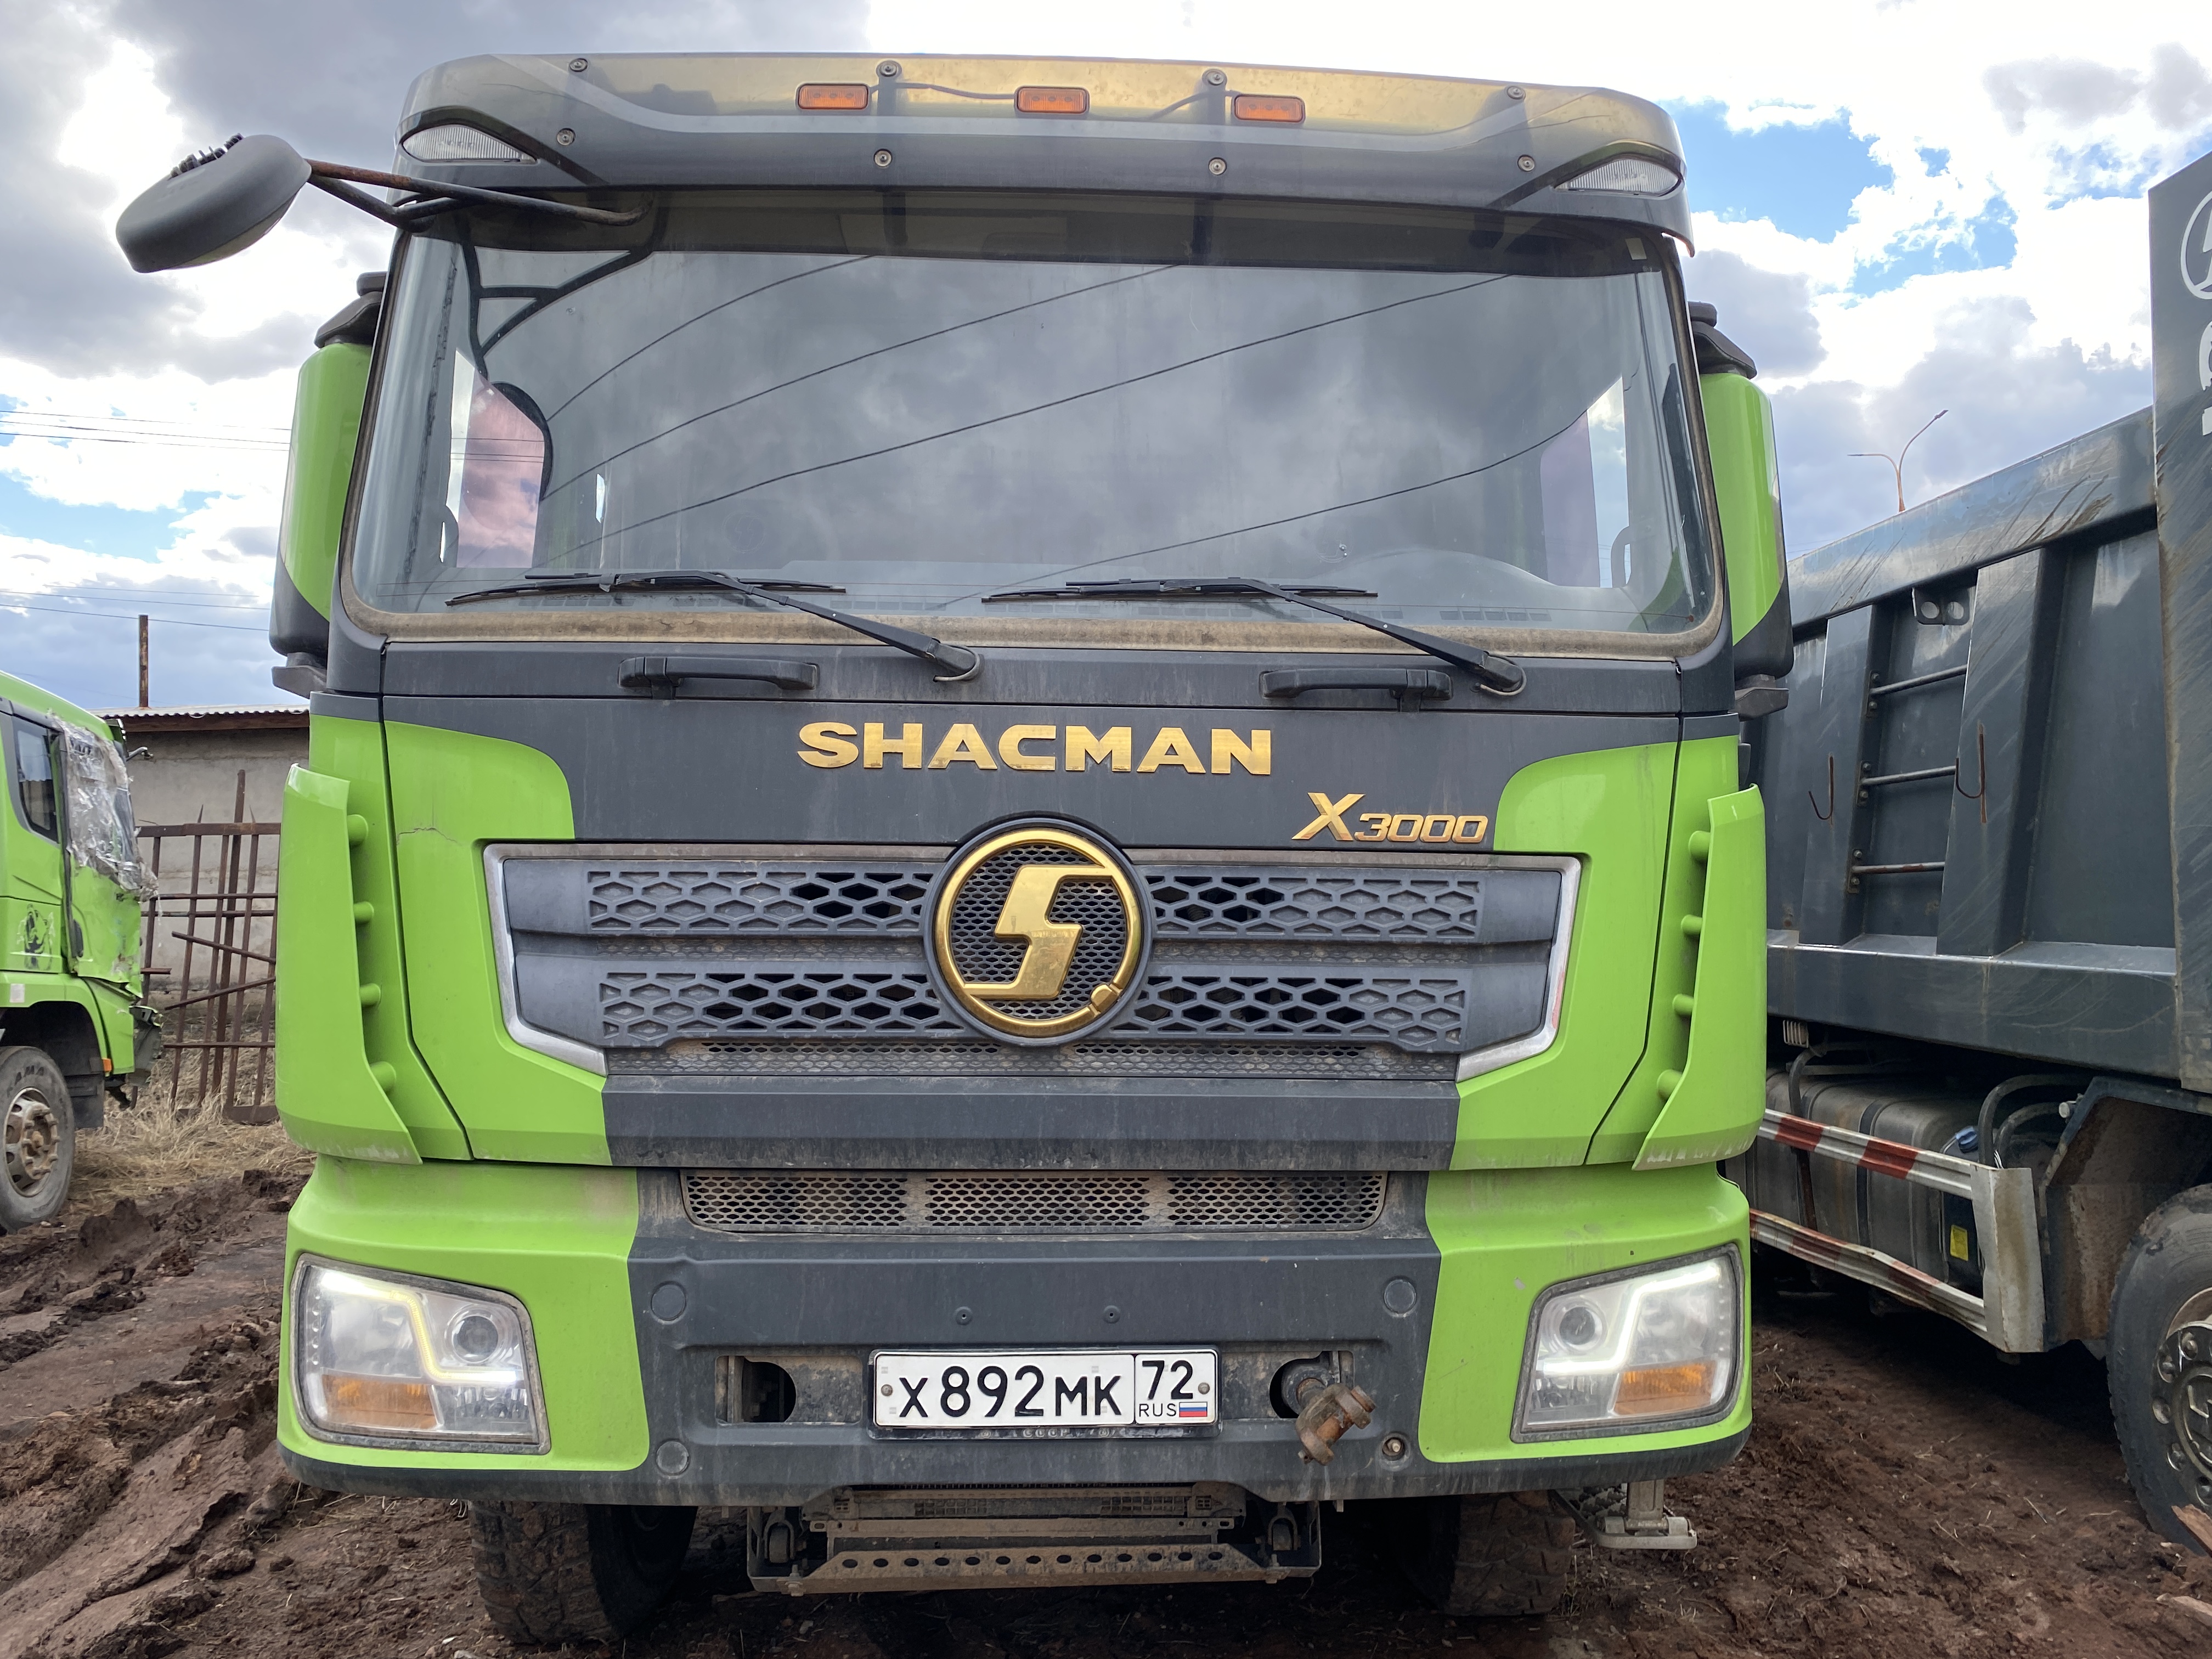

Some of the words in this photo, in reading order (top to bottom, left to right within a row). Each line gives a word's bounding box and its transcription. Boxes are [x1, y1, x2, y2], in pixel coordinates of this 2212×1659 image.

[797, 721, 1271, 775] SHACMAN
[1291, 792, 1489, 844] X3000
[1142, 1360, 1193, 1400] 72
[1139, 1403, 1177, 1417] RUS
